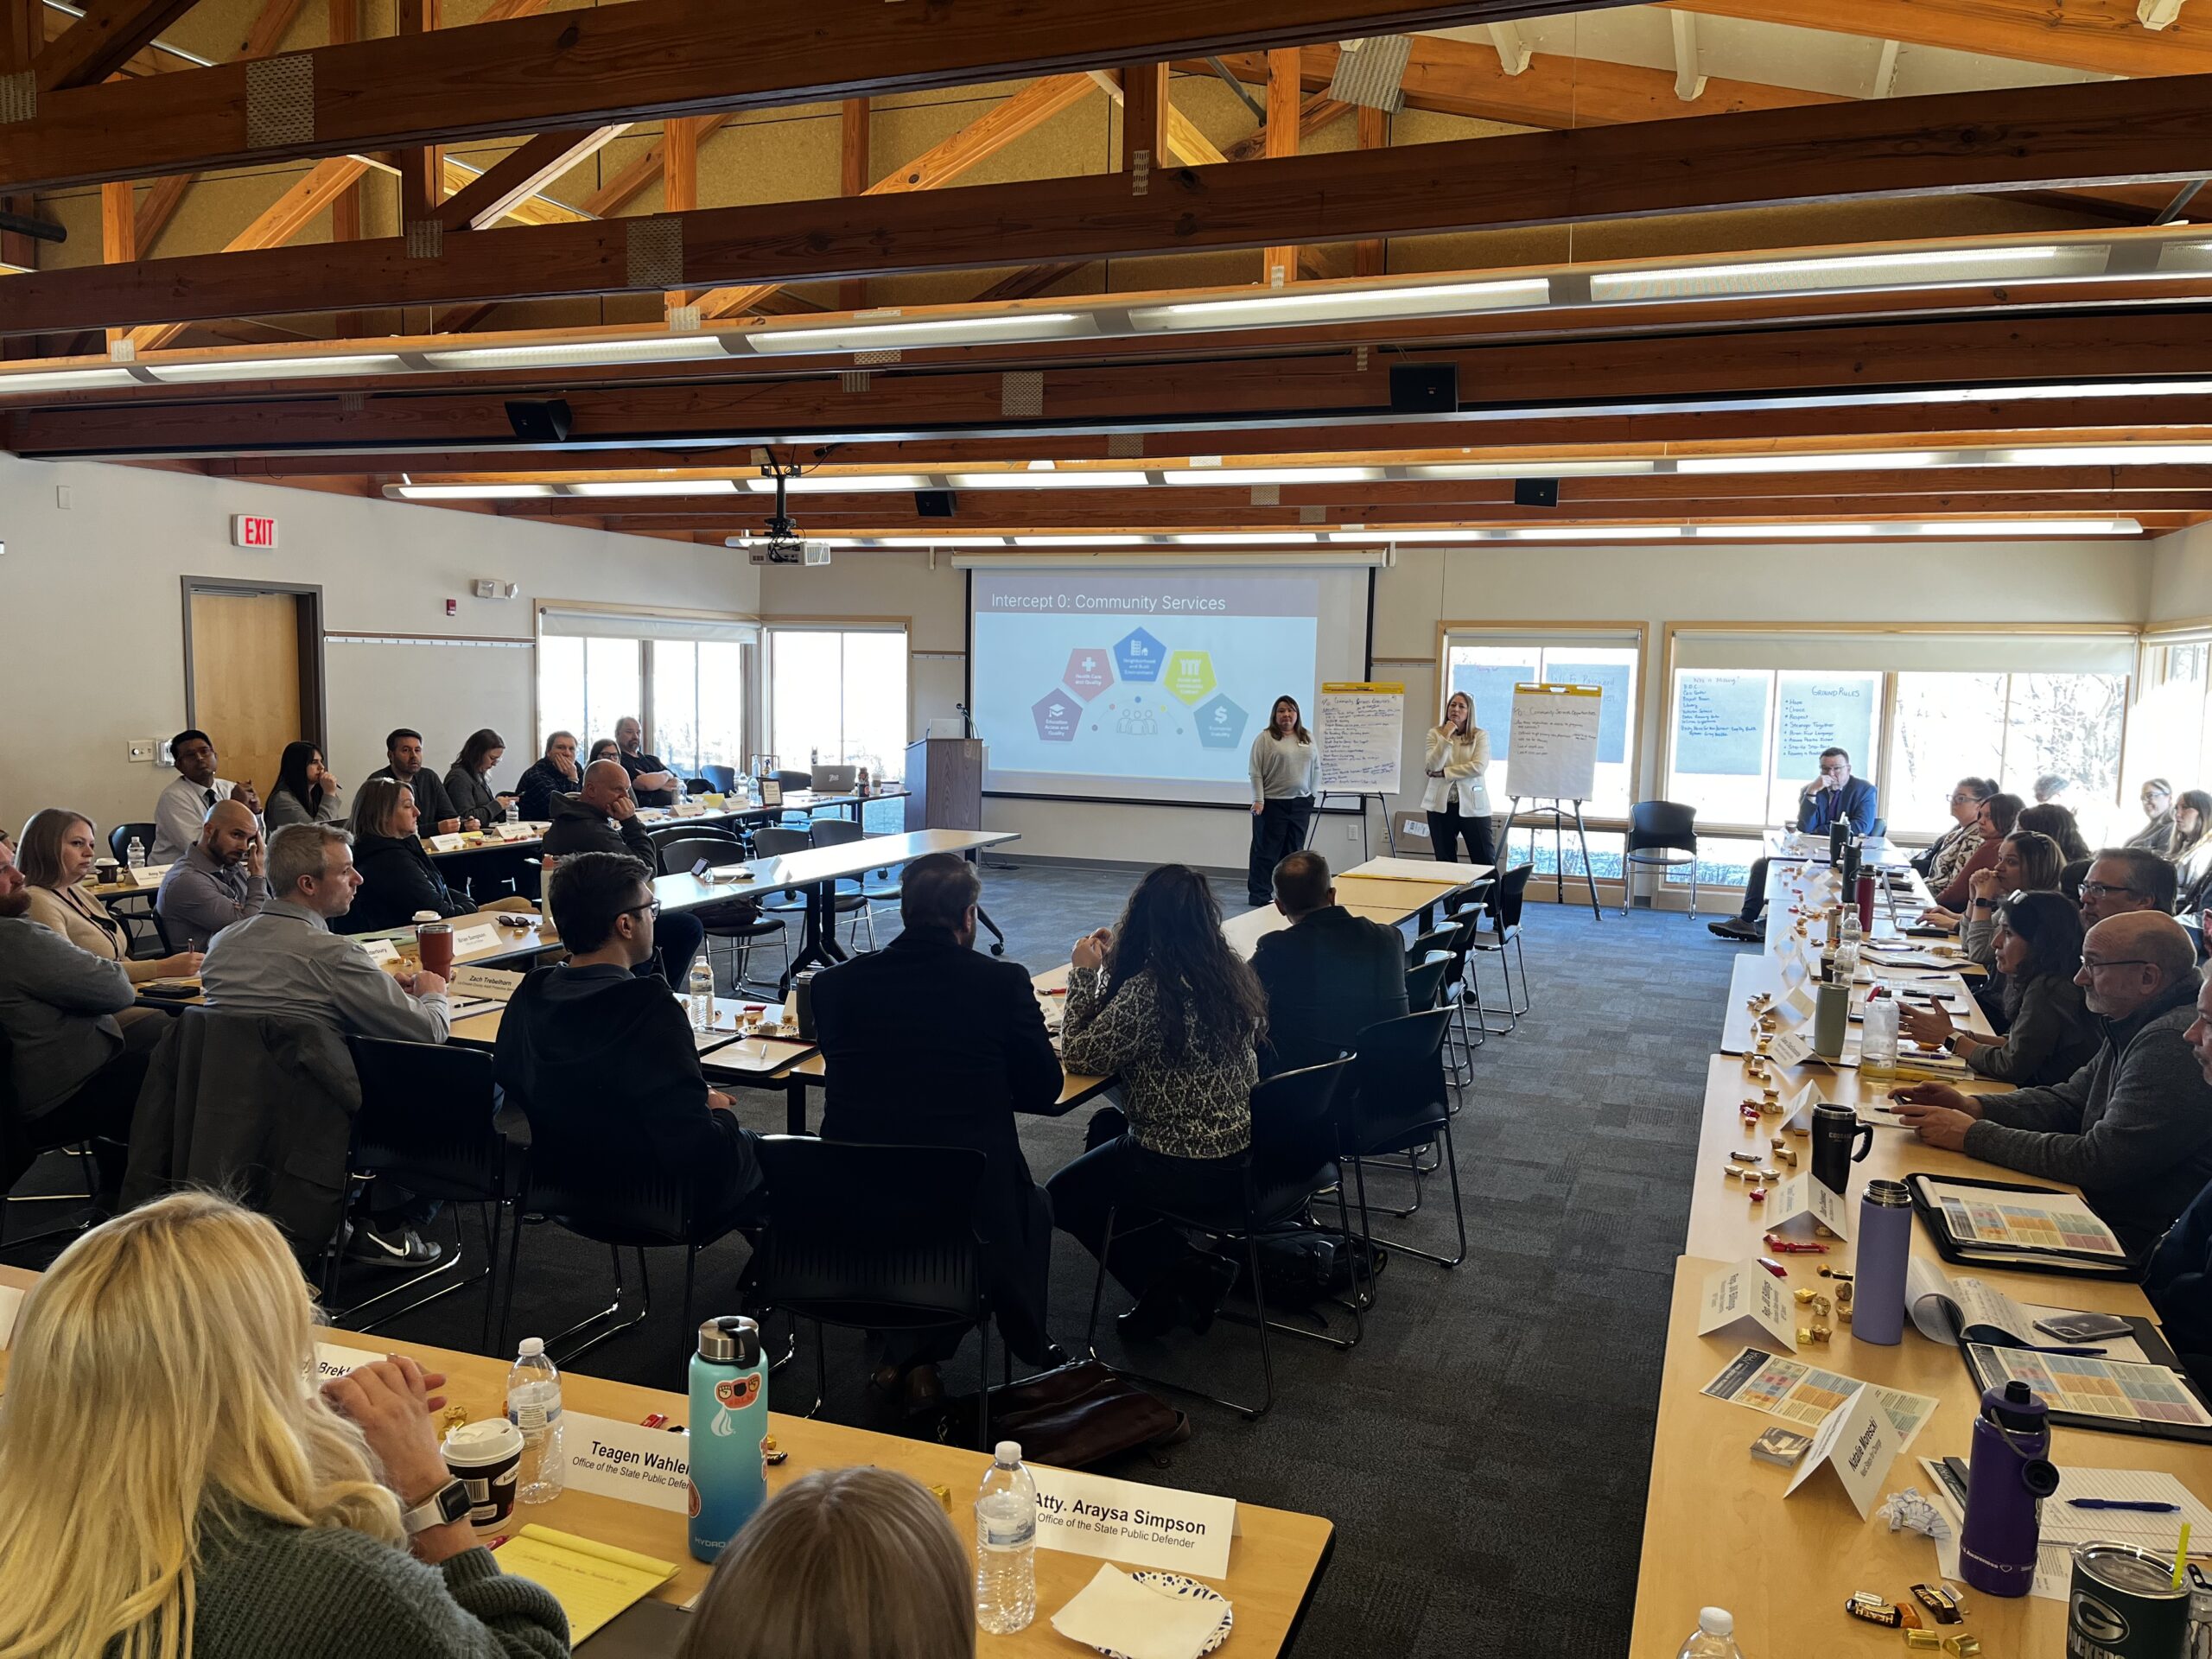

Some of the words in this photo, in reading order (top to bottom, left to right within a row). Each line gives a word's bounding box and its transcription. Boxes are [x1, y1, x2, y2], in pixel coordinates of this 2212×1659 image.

[245, 518, 274, 545] EXIT
[992, 594, 1053, 610] Intercept
[1058, 594, 1071, 608] 0:
[1076, 594, 1157, 612] Community
[1162, 595, 1226, 610] Services
[1839, 687, 1860, 697] RULES
[484, 977, 512, 986] Trebelhorn
[592, 1440, 639, 1464] Teagen
[572, 1456, 595, 1469] Office
[606, 1464, 618, 1474] the
[620, 1467, 641, 1479] State
[642, 1471, 667, 1485] Public
[667, 1477, 689, 1490] Defe
[1036, 1493, 1067, 1513] Atty.
[1072, 1499, 1129, 1522] Araysa
[1134, 1509, 1206, 1535] Simpson
[1038, 1513, 1064, 1526] Office
[1066, 1518, 1077, 1528] of
[1077, 1519, 1092, 1530] the
[1094, 1522, 1119, 1536] State
[1121, 1527, 1149, 1541] Public
[1151, 1532, 1195, 1549] Defender
[694, 1536, 726, 1548] HYDRO
[1855, 1605, 1894, 1624] HEATH
